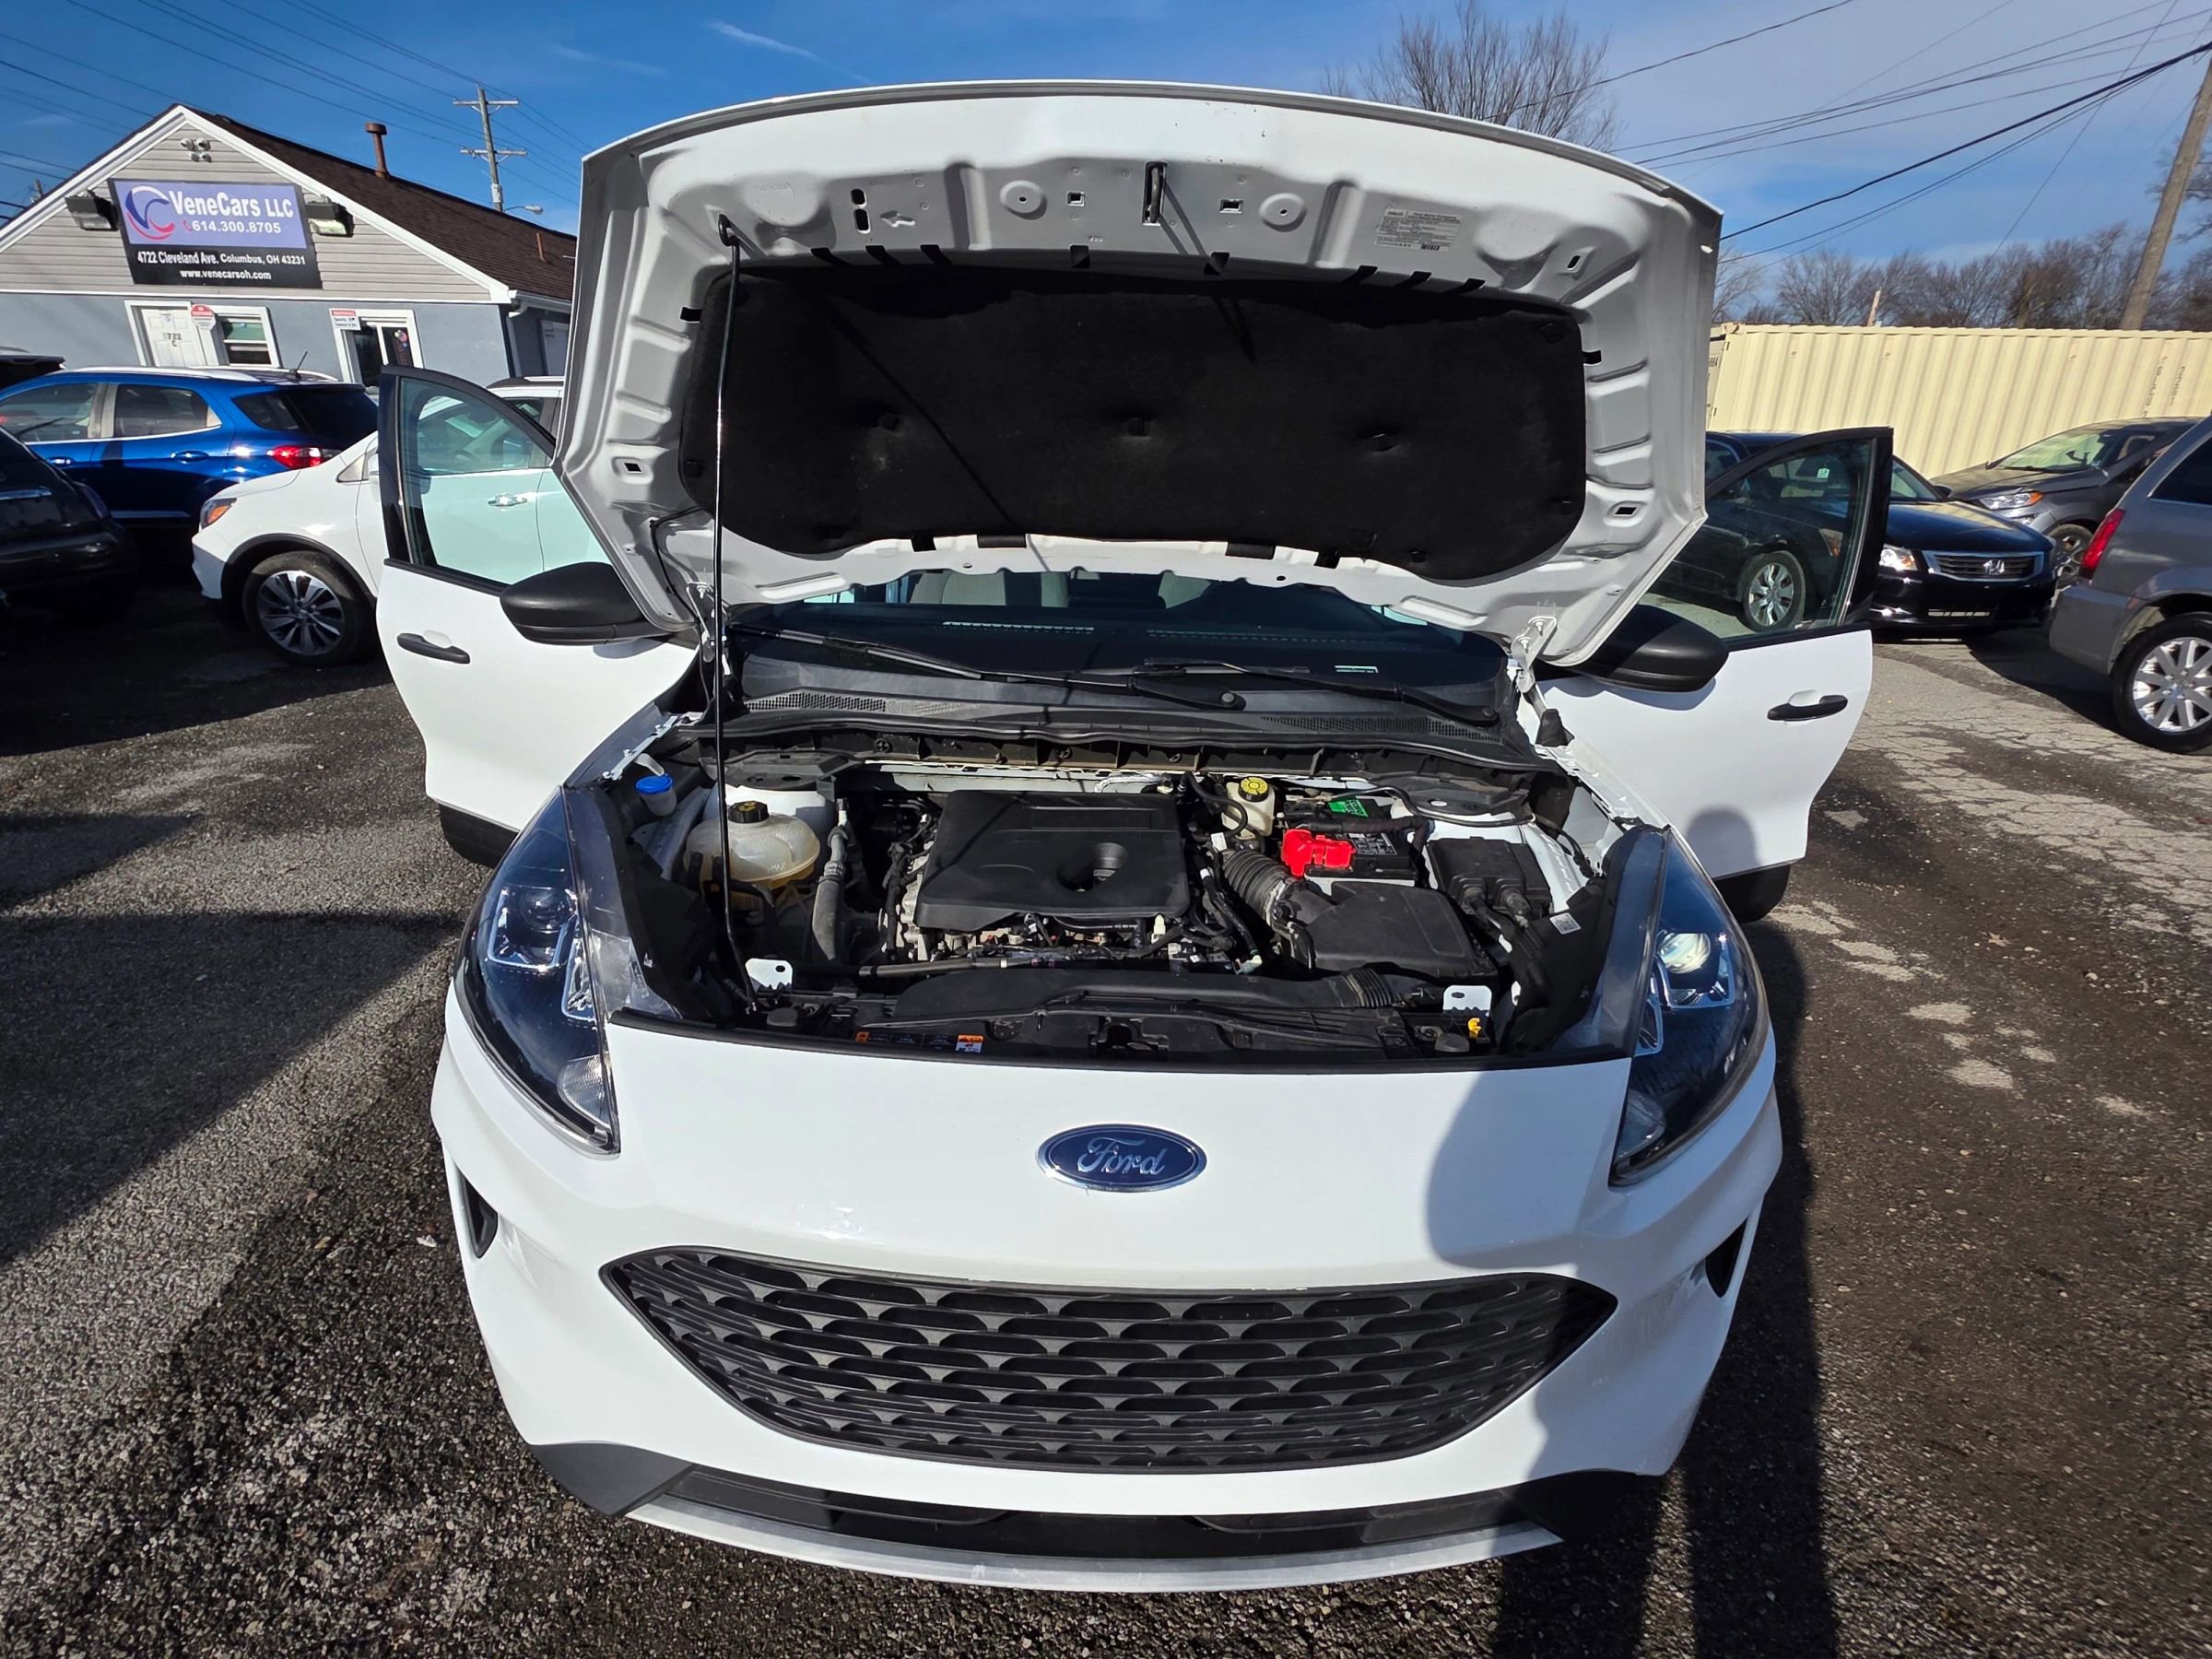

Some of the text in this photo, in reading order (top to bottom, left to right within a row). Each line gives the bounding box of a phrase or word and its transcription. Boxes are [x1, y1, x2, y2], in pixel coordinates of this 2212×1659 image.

[169, 190, 294, 218] VeneCars LLC
[192, 220, 282, 233] 614.300.8705
[137, 251, 306, 265] 4722 Cleveland Ave. Columbus, OH 43231
[180, 269, 272, 280] www.venecarsoh.com
[1077, 1135, 1169, 1176] Ford
